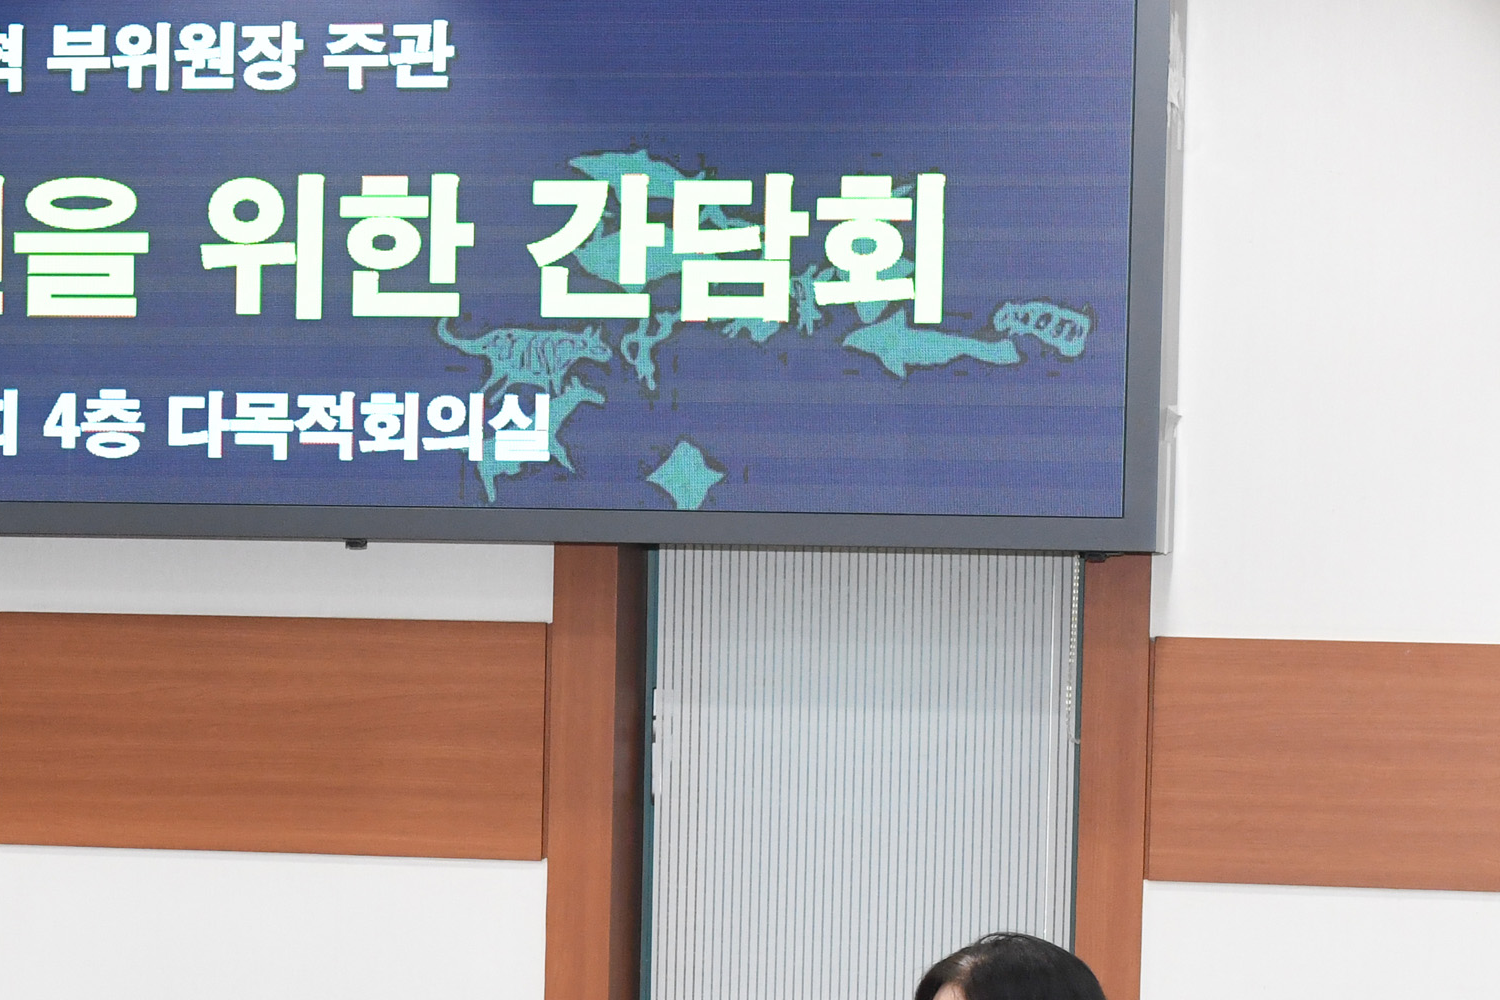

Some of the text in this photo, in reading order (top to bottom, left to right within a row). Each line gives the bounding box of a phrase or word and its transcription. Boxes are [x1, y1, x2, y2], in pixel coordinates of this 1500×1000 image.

[46, 20, 304, 92] 부위원장
[322, 19, 455, 90] 주관
[200, 173, 475, 320] 위한
[526, 172, 947, 324] 간담회
[43, 388, 146, 459] 4층
[168, 390, 552, 462] 다목적회의실
